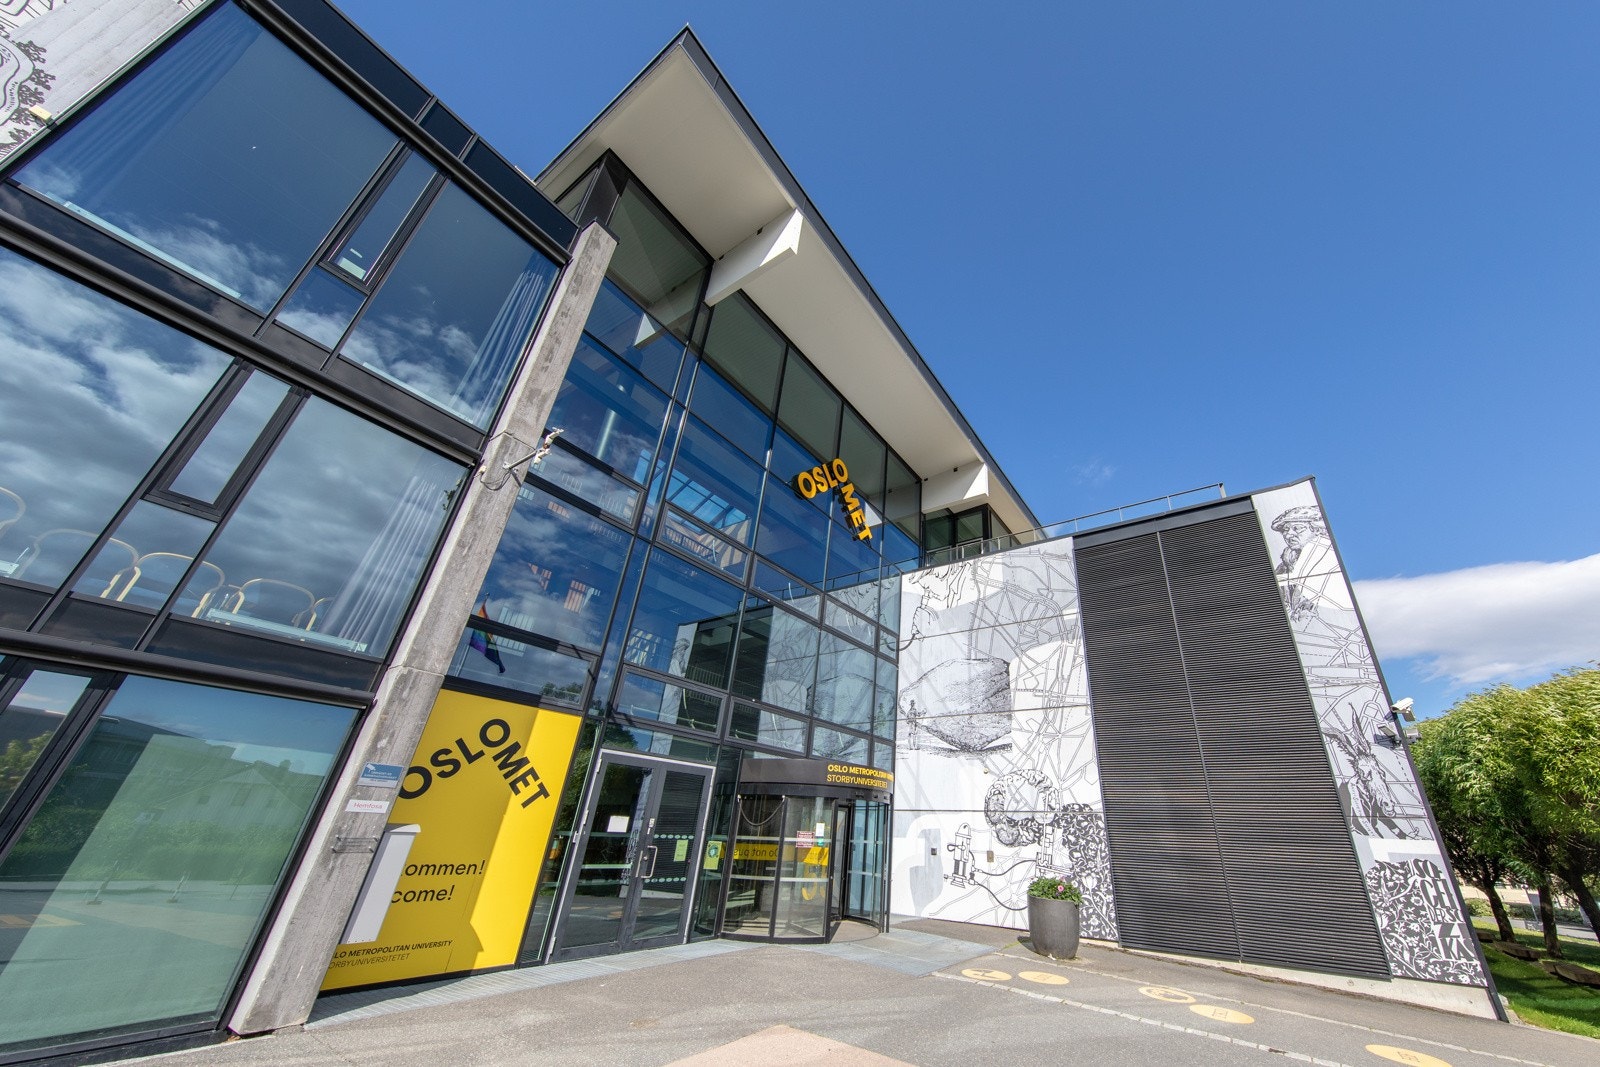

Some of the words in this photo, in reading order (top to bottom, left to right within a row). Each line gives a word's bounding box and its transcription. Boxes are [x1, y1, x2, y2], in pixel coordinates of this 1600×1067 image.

[827, 764, 848, 773] OSLO
[400, 860, 486, 877] ommen!
[391, 884, 455, 904] come!
[348, 944, 412, 957] METROPOLITAN
[411, 940, 453, 950] UNIVERSITY
[329, 953, 411, 969] ORBYUNIVERSITETET
